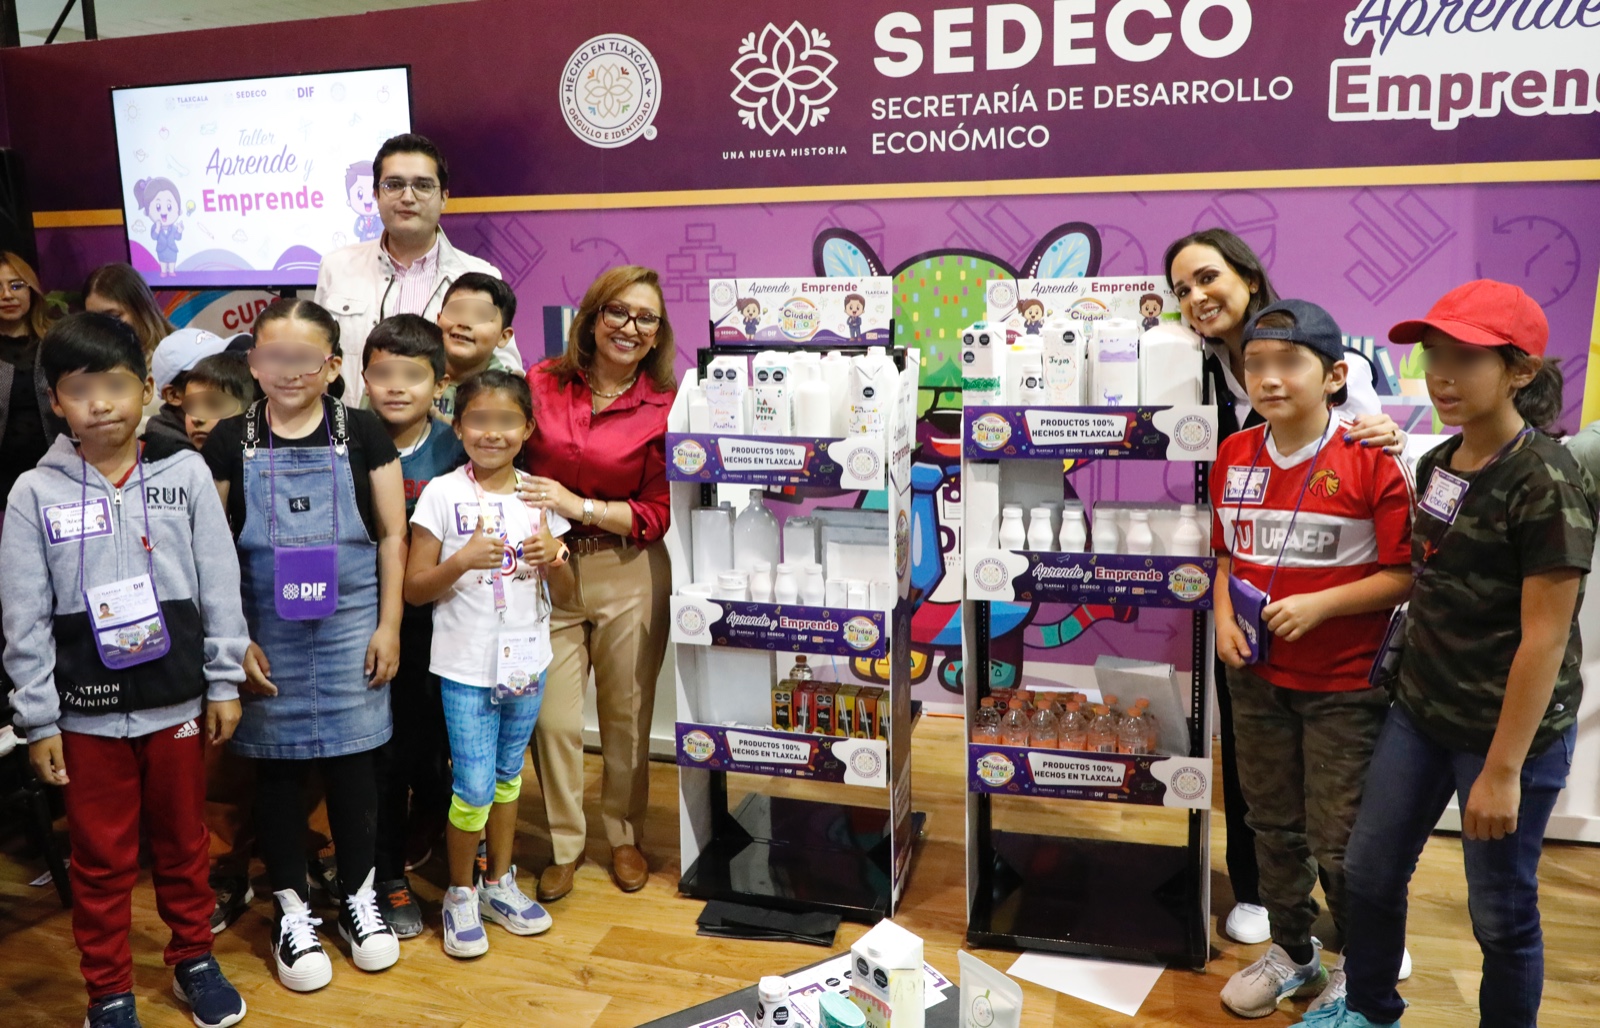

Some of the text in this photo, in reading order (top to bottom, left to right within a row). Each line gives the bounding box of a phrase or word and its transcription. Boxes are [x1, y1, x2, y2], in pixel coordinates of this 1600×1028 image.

[1351, 0, 1600, 56] Aprende
[873, 0, 1252, 78] SEDECO
[565, 42, 652, 92] HECHO EN TLAXCALA
[236, 90, 266, 98] SEDECO
[297, 87, 314, 98] DIF
[872, 76, 1293, 120] SECRETARÍA DE DESARROLLO
[1335, 65, 1600, 122] Empren
[569, 108, 601, 138] ORGULLO
[612, 102, 650, 139] IDENTIDAD
[238, 128, 276, 147] Taller
[872, 123, 1050, 154] ECONÓMICO
[722, 146, 847, 160] UNA NUEVA HISTORIA
[205, 145, 314, 184] Aprende y
[202, 186, 324, 216] Emprende
[749, 282, 790, 296] Aprende
[802, 283, 857, 294] Emprende
[1031, 282, 1078, 297] Aprende
[1092, 282, 1155, 294] Emprende
[784, 310, 813, 320] Ciudad
[1071, 311, 1104, 321] Ciudad
[978, 423, 1004, 433] Ciudad
[678, 449, 700, 458] Ciudad
[146, 486, 188, 505] RUN
[1238, 525, 1334, 552] U UPAEP
[1032, 562, 1163, 583] Aprende y Emprende
[1174, 574, 1202, 584] Ciudad
[133, 582, 144, 590] DIF
[301, 583, 326, 596] DIF
[726, 611, 838, 632] Aprende y Emprende
[848, 625, 873, 635] Ciudad
[75, 683, 120, 695] ATHON
[65, 692, 118, 707] TRAINING
[174, 727, 200, 739] adidas
[687, 738, 709, 748] Ciudad
[739, 740, 779, 749] PRODUCTOS
[772, 752, 807, 760] TLAXCALA
[982, 762, 1007, 771] Ciudad
[1043, 762, 1113, 772] PRODUCTOS 100%
[1081, 774, 1122, 782] TLAXCALA
